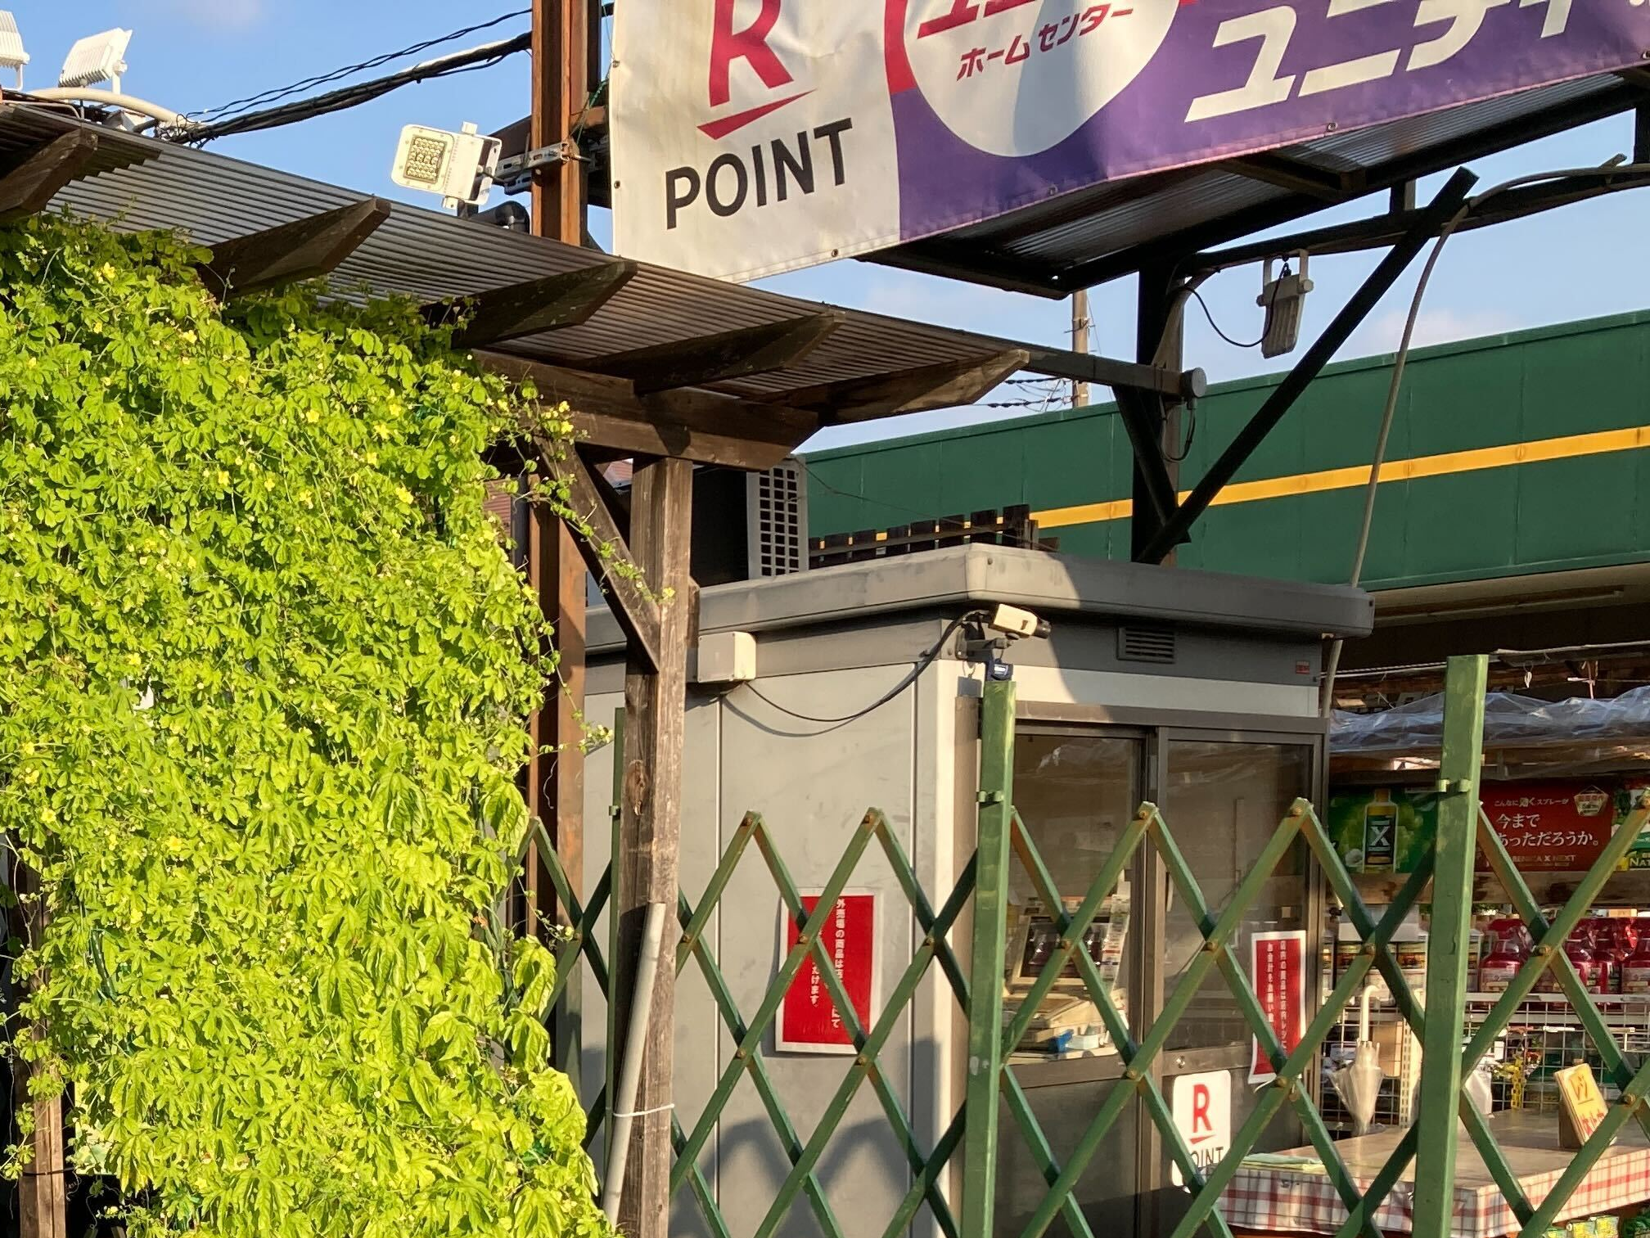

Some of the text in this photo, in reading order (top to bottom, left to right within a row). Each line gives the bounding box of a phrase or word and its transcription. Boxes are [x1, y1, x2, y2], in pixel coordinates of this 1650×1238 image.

[956, 3, 1134, 82] ホームセンター
[665, 117, 853, 230] POINT
[1497, 813, 1540, 829] 今まで
[1193, 1084, 1212, 1133] R
[1190, 1146, 1224, 1169] OINT
